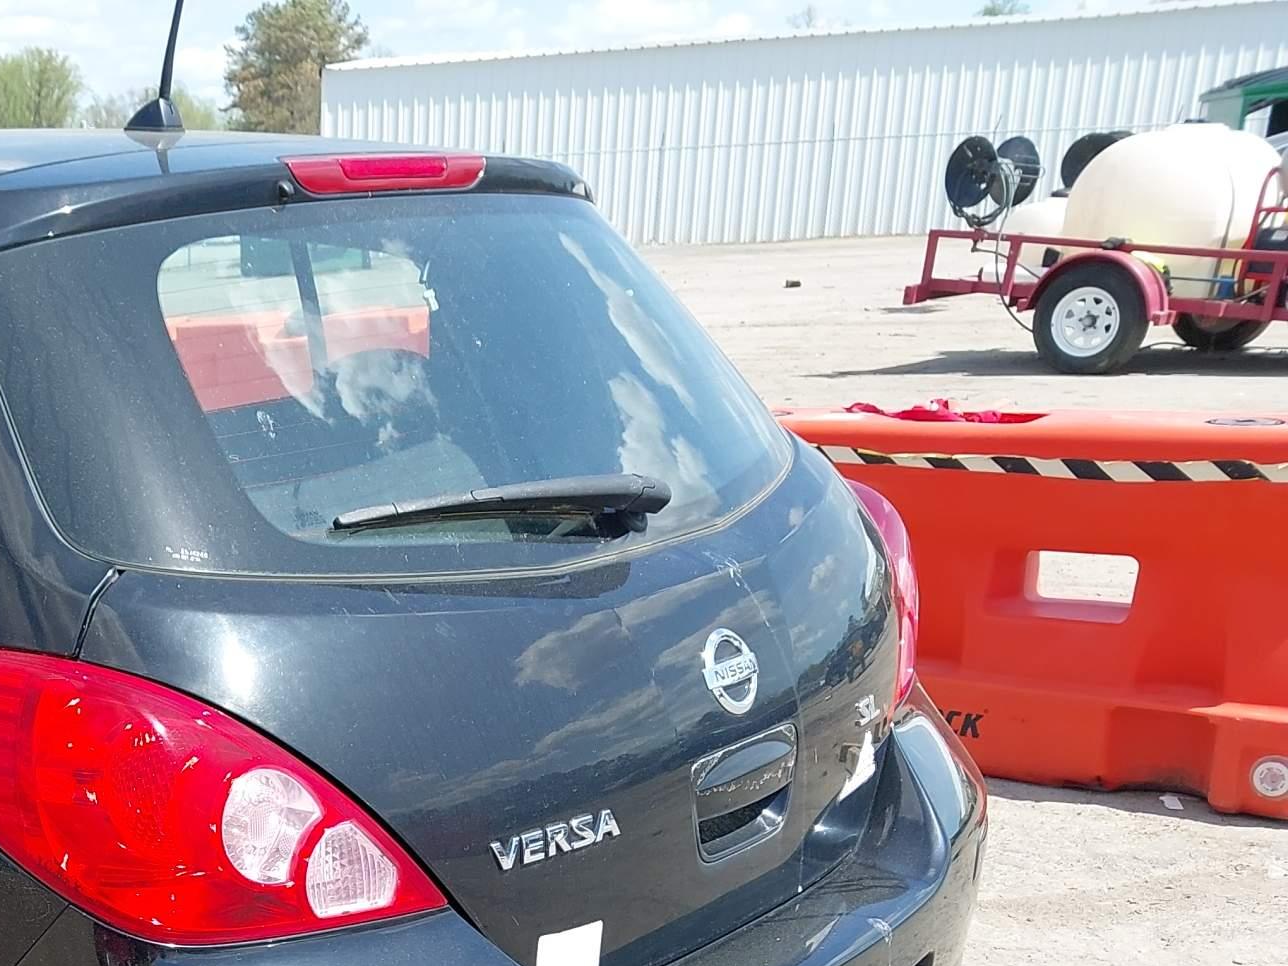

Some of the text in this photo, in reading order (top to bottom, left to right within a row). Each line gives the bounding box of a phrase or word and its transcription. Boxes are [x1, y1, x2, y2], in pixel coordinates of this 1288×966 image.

[714, 658, 757, 682] NISSAN
[855, 694, 880, 727] SL
[489, 808, 622, 872] VERSA
